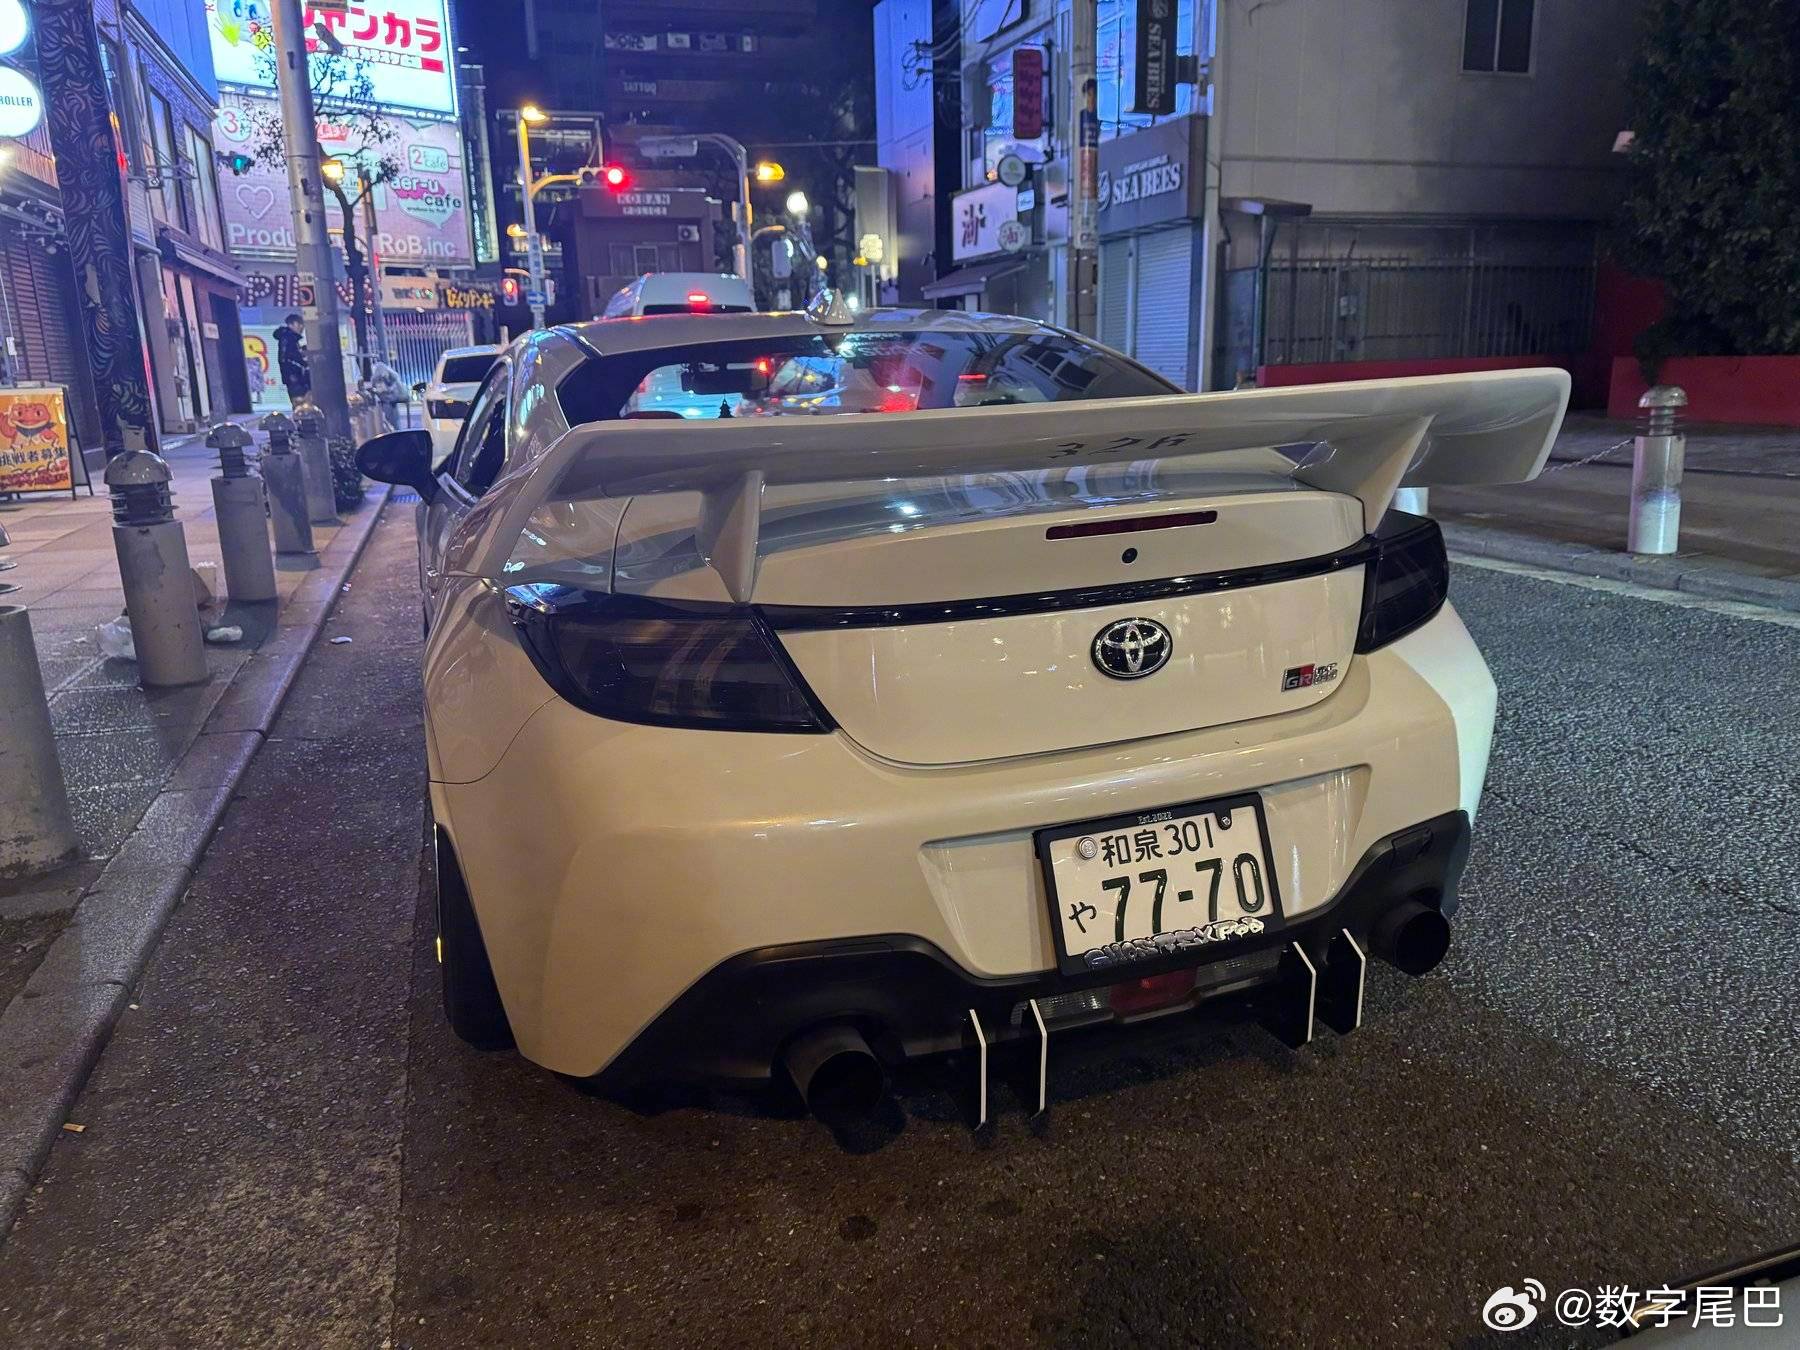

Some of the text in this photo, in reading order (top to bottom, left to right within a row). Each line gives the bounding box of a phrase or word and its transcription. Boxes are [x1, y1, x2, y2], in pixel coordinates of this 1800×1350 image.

[1146, 22, 1161, 108] SEA BEES
[1112, 173, 1140, 205] SEA
[1141, 161, 1182, 199] BEES
[1286, 673, 1313, 690] GR
[1068, 852, 1265, 942] や 77-70
